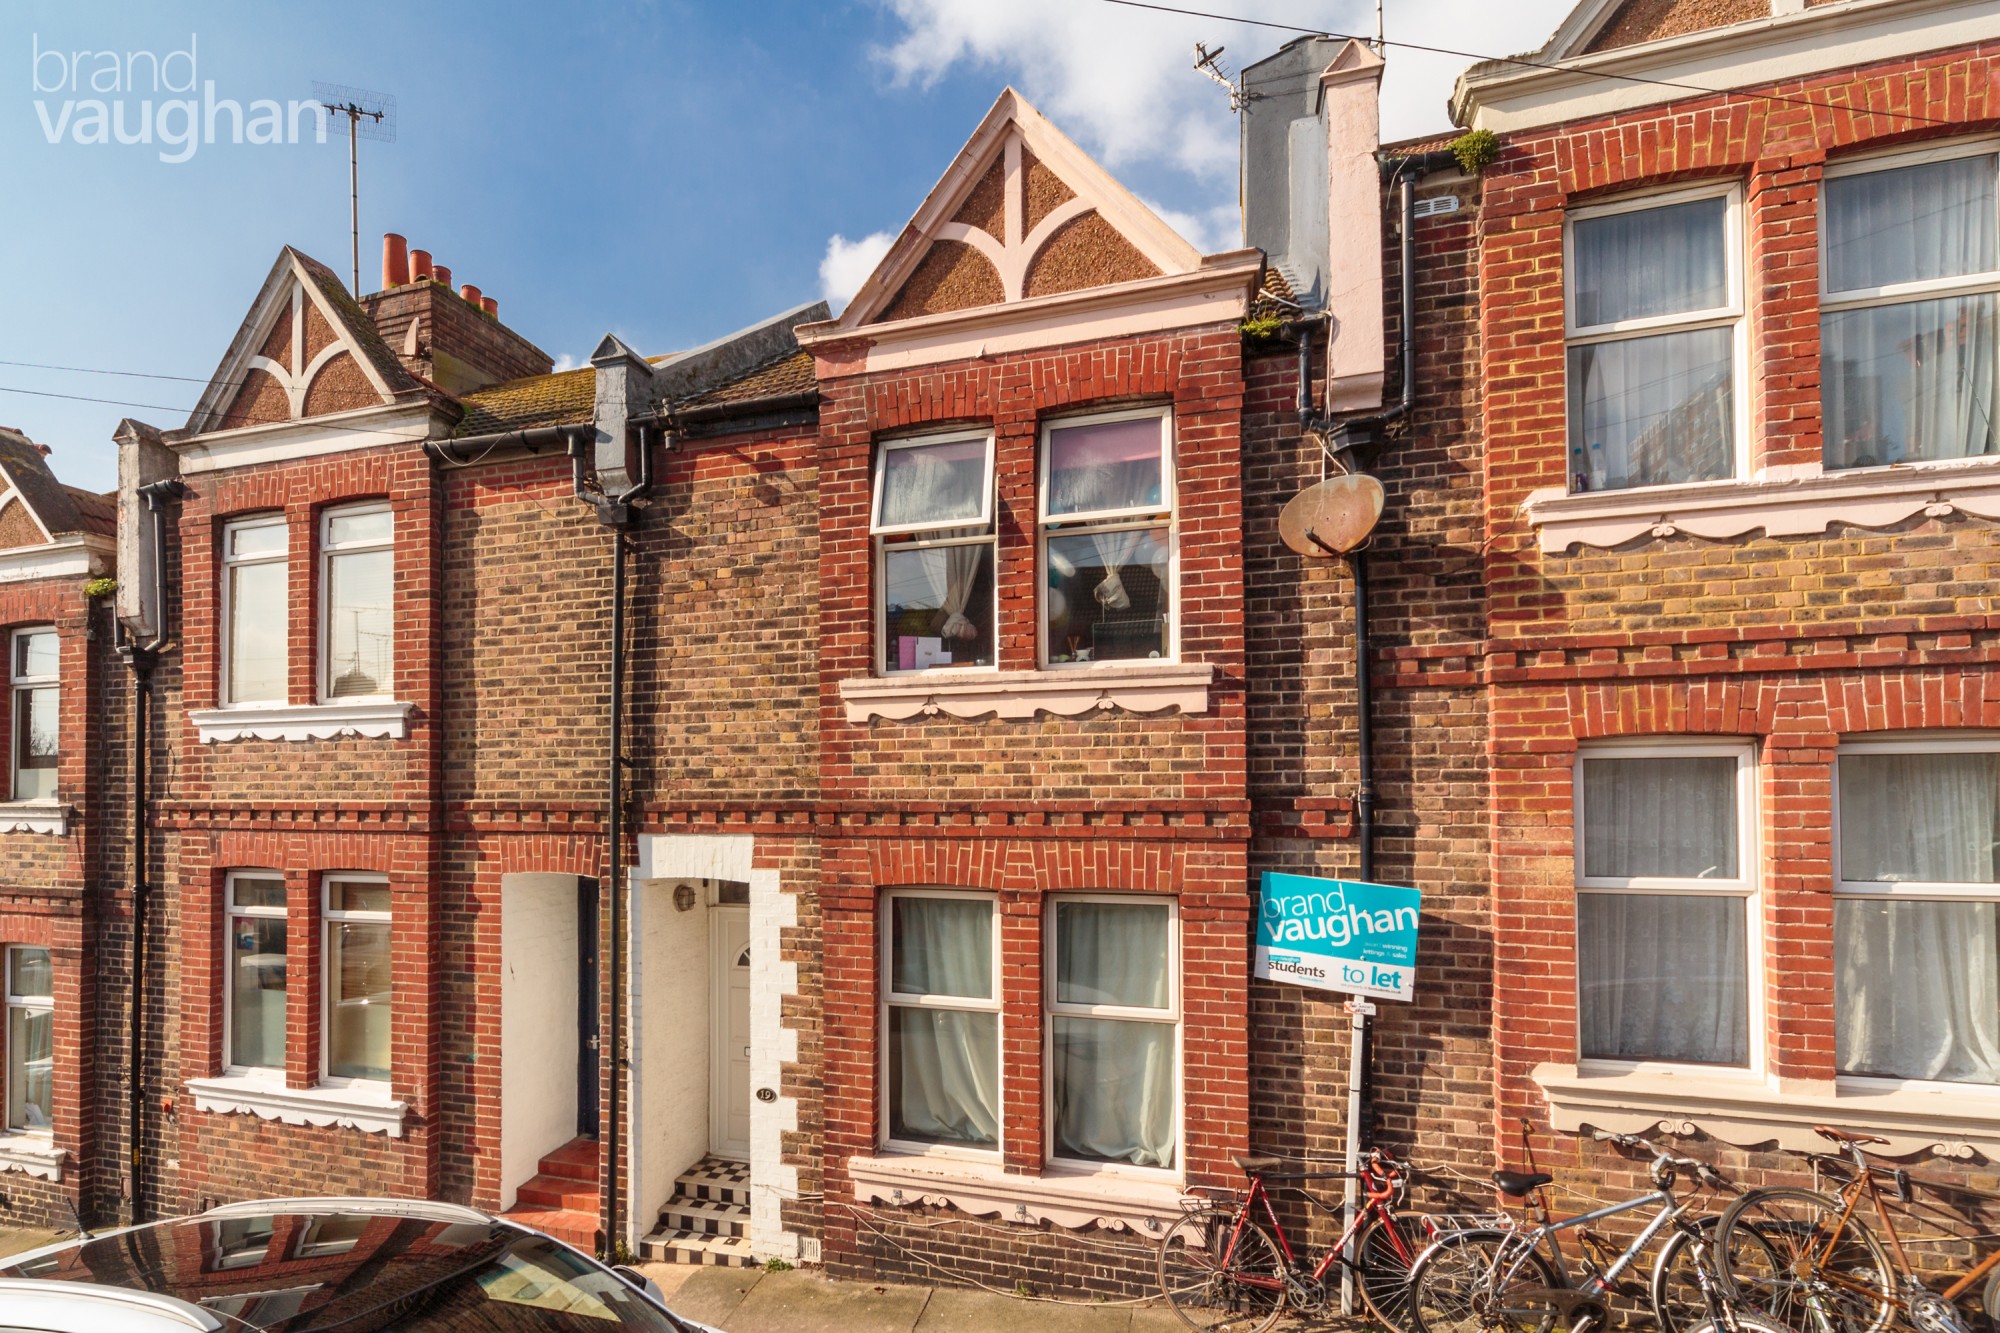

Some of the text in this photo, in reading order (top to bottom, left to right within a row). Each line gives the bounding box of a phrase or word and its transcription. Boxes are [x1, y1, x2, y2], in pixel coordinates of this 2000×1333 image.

[1260, 883, 1347, 919] brand
[1265, 904, 1418, 947] vaughan
[1363, 948, 1385, 957] lettings
[1382, 943, 1408, 953] winning
[1268, 960, 1326, 978] students
[1342, 965, 1365, 983] to
[1371, 966, 1402, 989] let
[760, 1090, 771, 1099] 19
